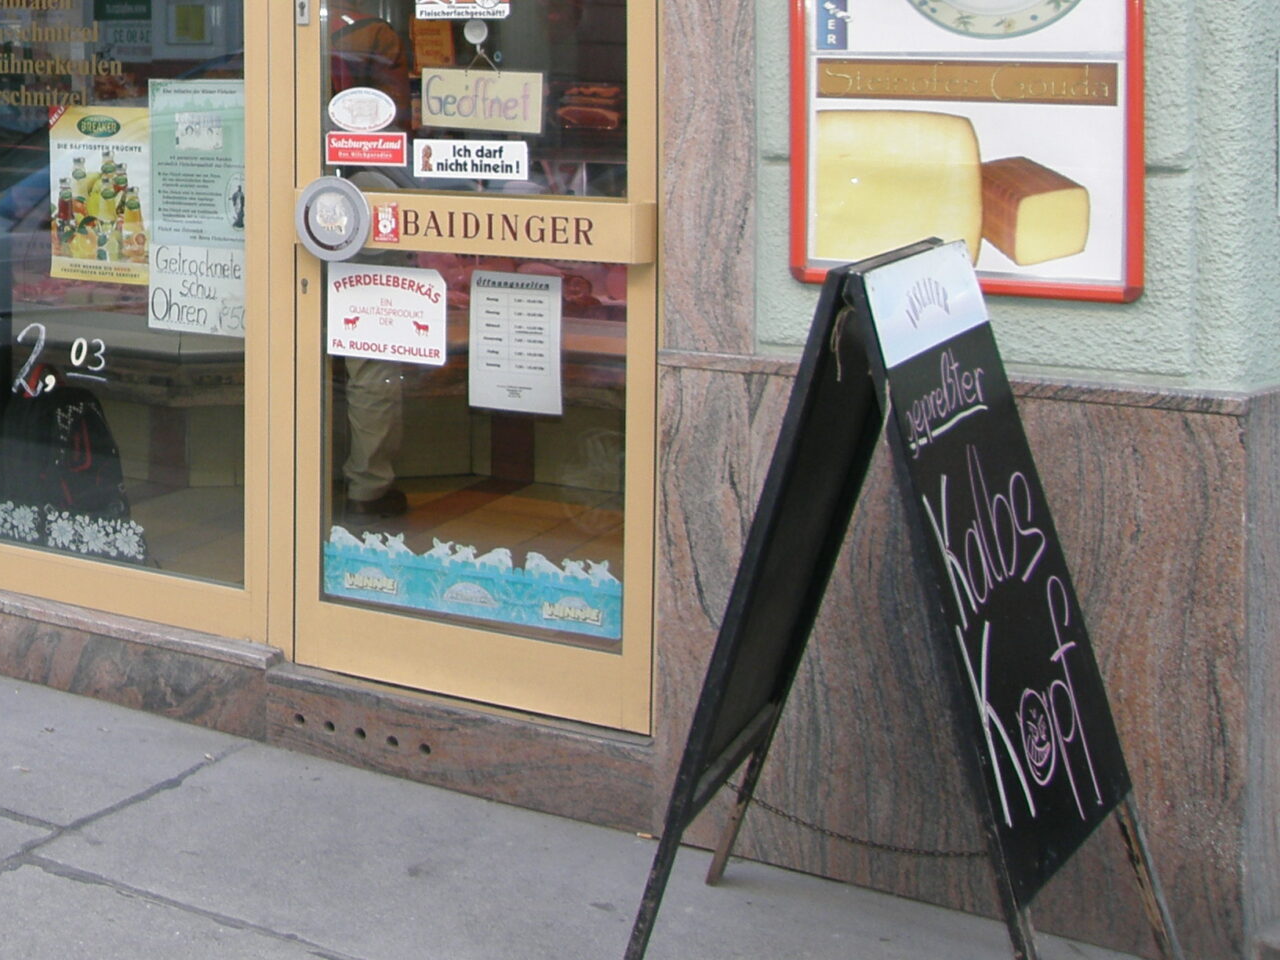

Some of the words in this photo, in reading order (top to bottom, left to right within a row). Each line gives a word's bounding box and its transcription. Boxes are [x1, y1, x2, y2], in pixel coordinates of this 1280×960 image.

[426, 75, 531, 121] Geöffnet
[452, 145, 472, 158] Ich
[475, 145, 504, 159] darf
[436, 159, 468, 172] nicht
[402, 208, 594, 246] BAIDINGER
[333, 274, 441, 304] PFERDELEBERKÄS
[152, 286, 208, 325] Ohren
[349, 305, 424, 319] QUALITÄTSPRODUKT
[380, 298, 392, 306] EIN
[379, 317, 393, 326] DER
[332, 338, 345, 349] FA.
[349, 340, 388, 353] RUDOLF
[390, 344, 440, 359] SCHULLER
[922, 444, 1046, 631] Kalbs
[956, 575, 1104, 829] Kopf
